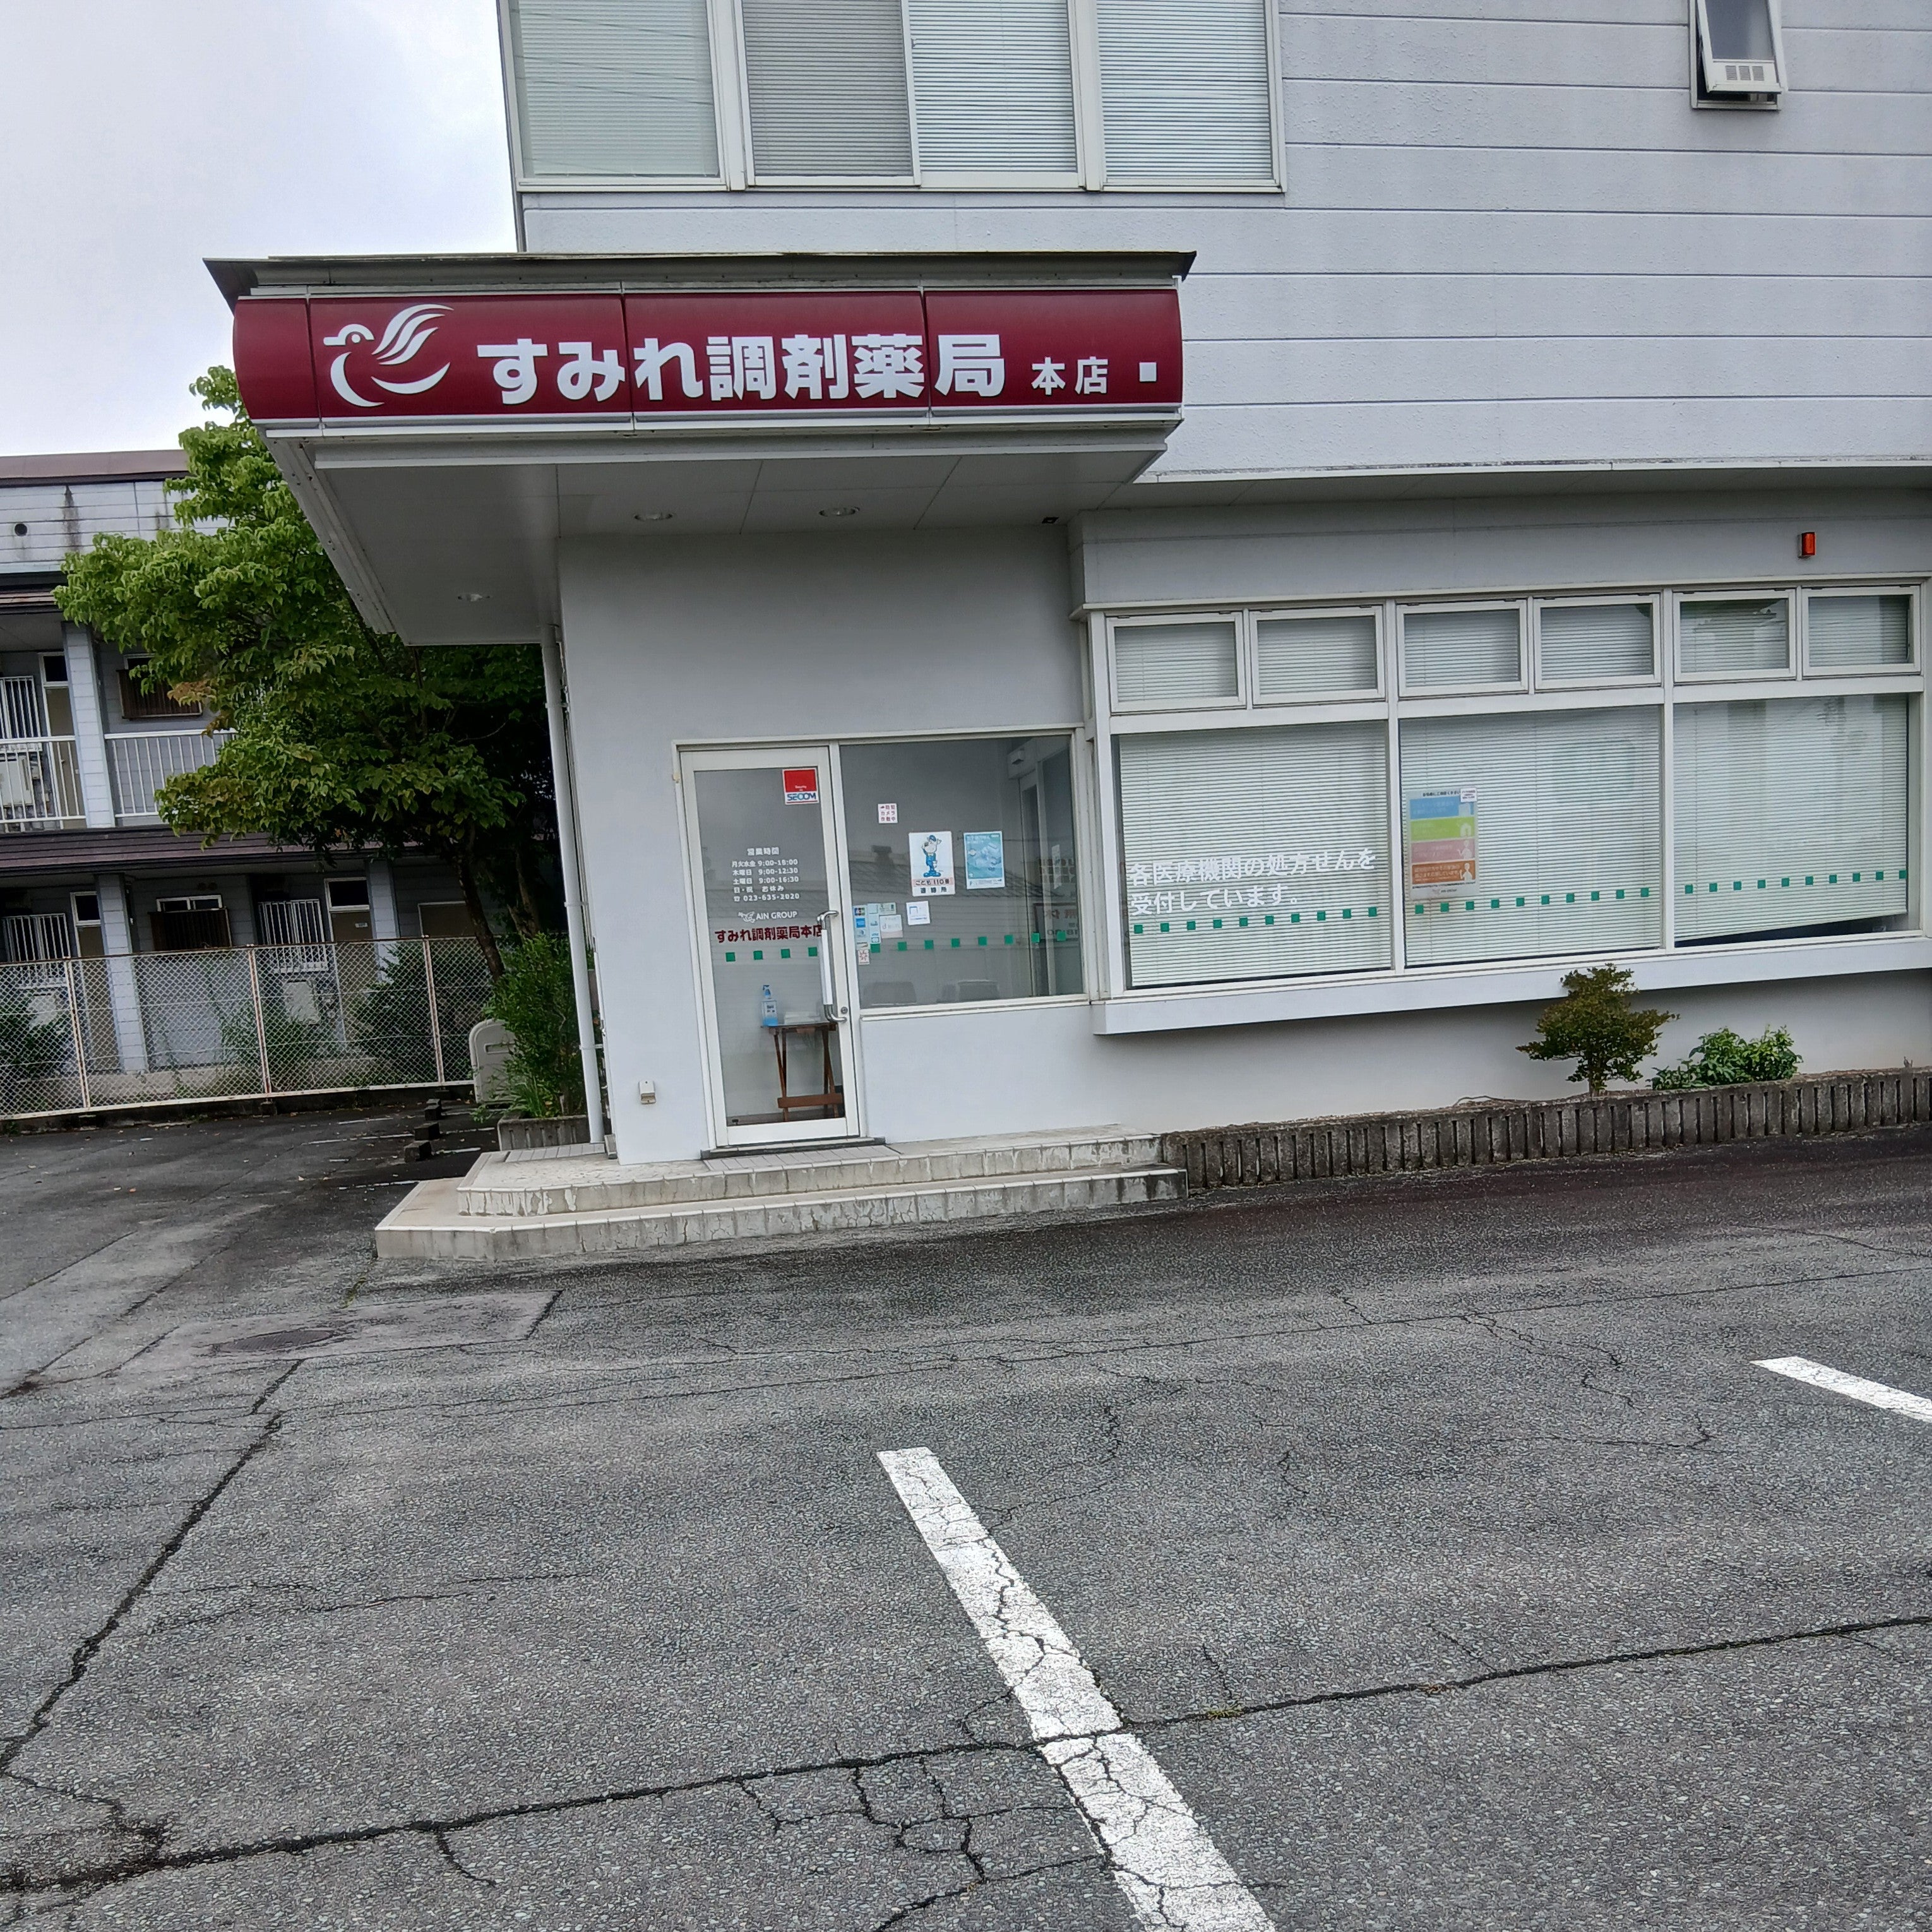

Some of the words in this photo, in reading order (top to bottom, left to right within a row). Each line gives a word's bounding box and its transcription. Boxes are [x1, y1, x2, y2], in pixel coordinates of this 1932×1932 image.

[477, 333, 1005, 405] すみれ調剤薬局
[1031, 355, 1108, 396] 本店
[787, 792, 816, 801] SECOM
[1129, 847, 1376, 886] 各医療機関の処方せんを
[1130, 883, 1298, 916] 受付しています。
[715, 924, 822, 943] すみれ調剤薬局本店
